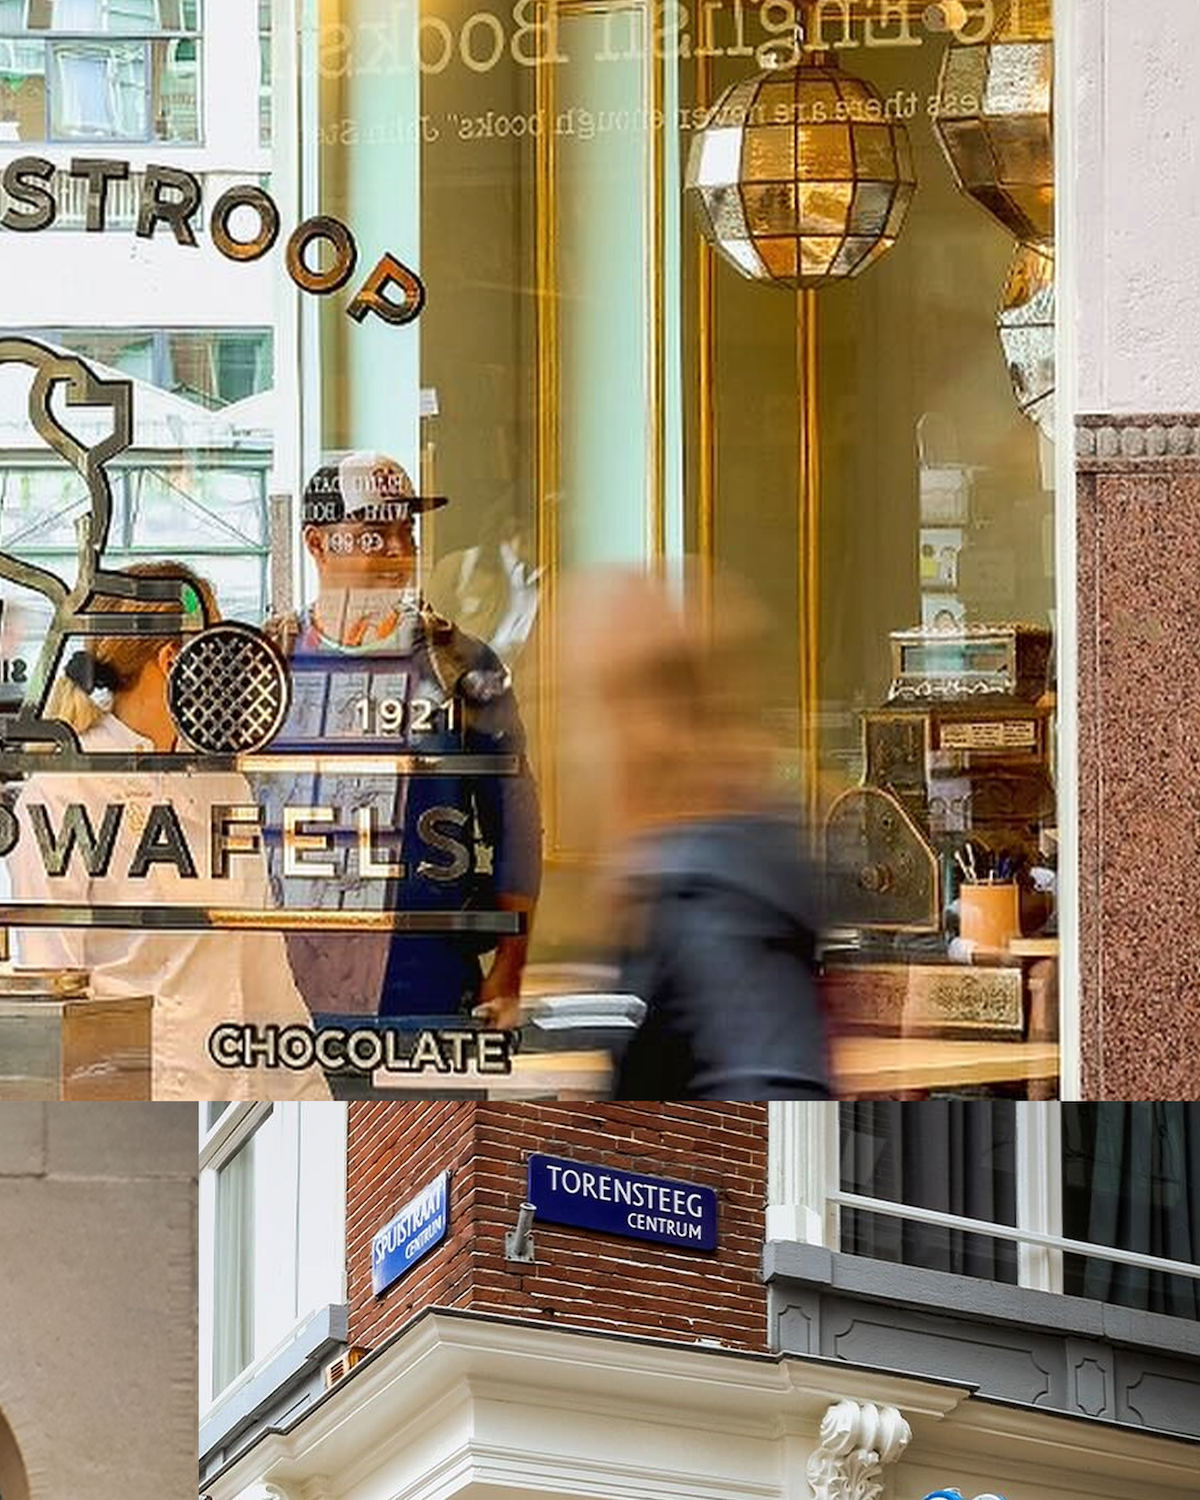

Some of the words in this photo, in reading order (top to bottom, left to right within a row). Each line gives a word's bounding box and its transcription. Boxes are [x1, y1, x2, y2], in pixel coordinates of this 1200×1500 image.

[1, 156, 428, 326] STROOP
[354, 698, 457, 734] 1921
[208, 1022, 514, 1074] CHOCOLATE
[545, 1163, 703, 1218] TORENSTEEG
[626, 1212, 703, 1240] CENTRUM
